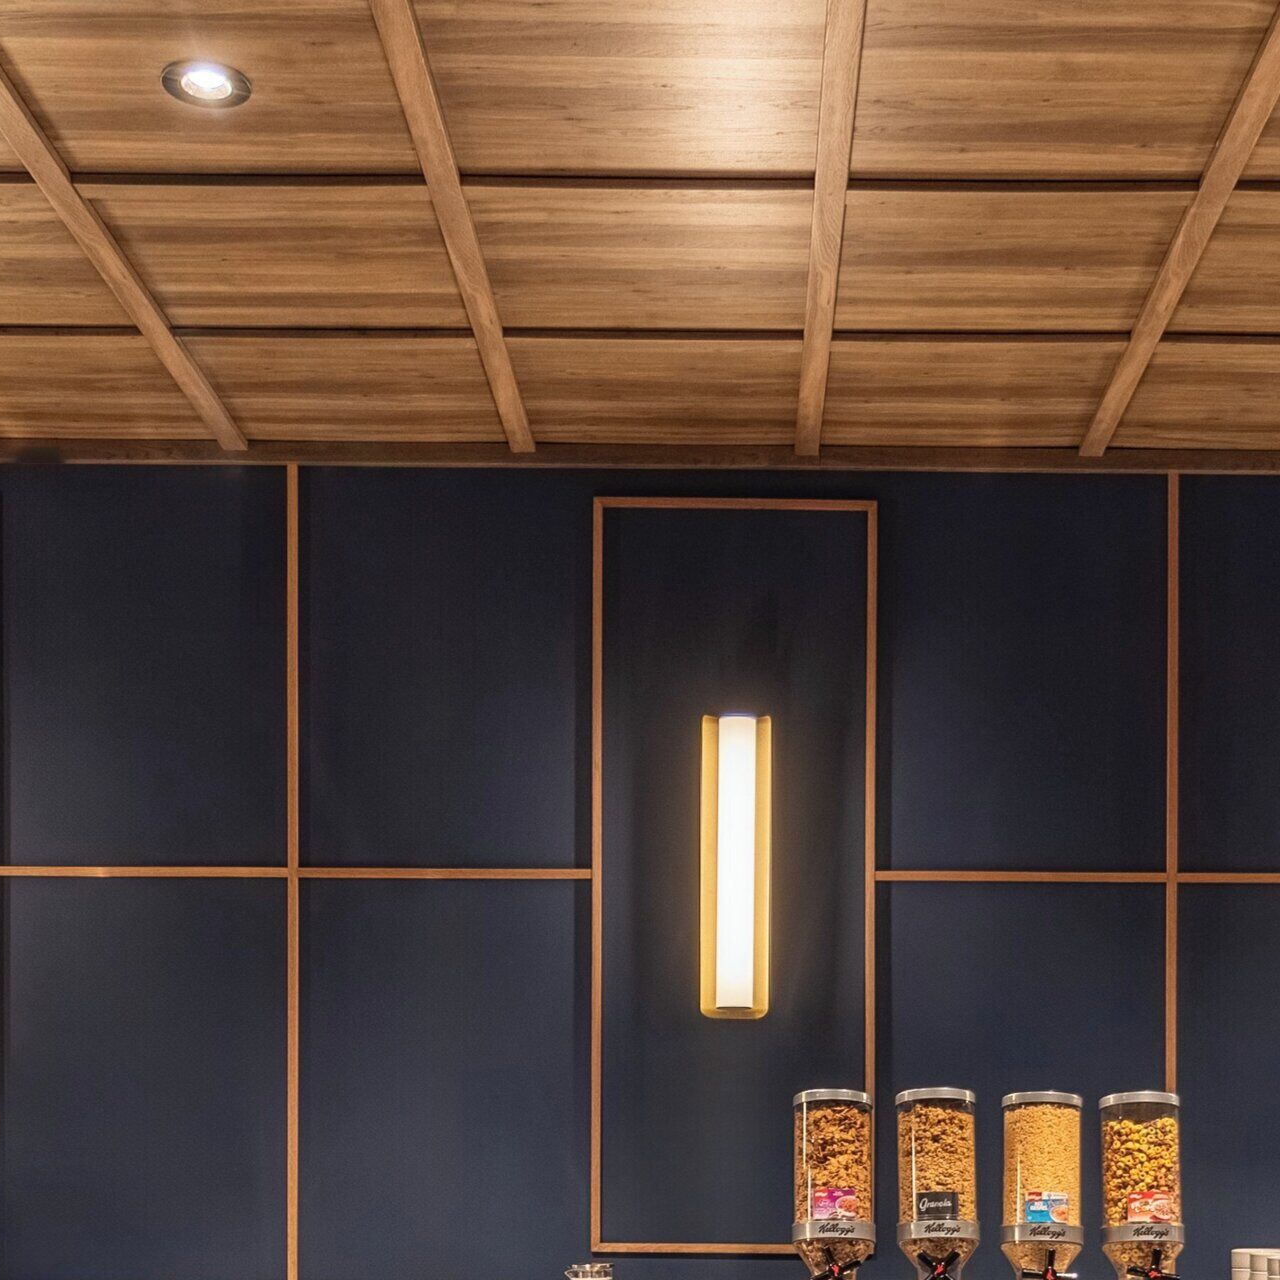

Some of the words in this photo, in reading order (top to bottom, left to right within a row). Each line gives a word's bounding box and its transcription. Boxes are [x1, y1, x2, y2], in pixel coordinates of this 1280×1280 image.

[919, 1198, 953, 1212] Granola
[818, 1222, 856, 1236] Kellogg's
[924, 1222, 962, 1236] Kellogg's
[1029, 1225, 1067, 1239] Kellogg's
[1132, 1225, 1170, 1239] Kellogg's
